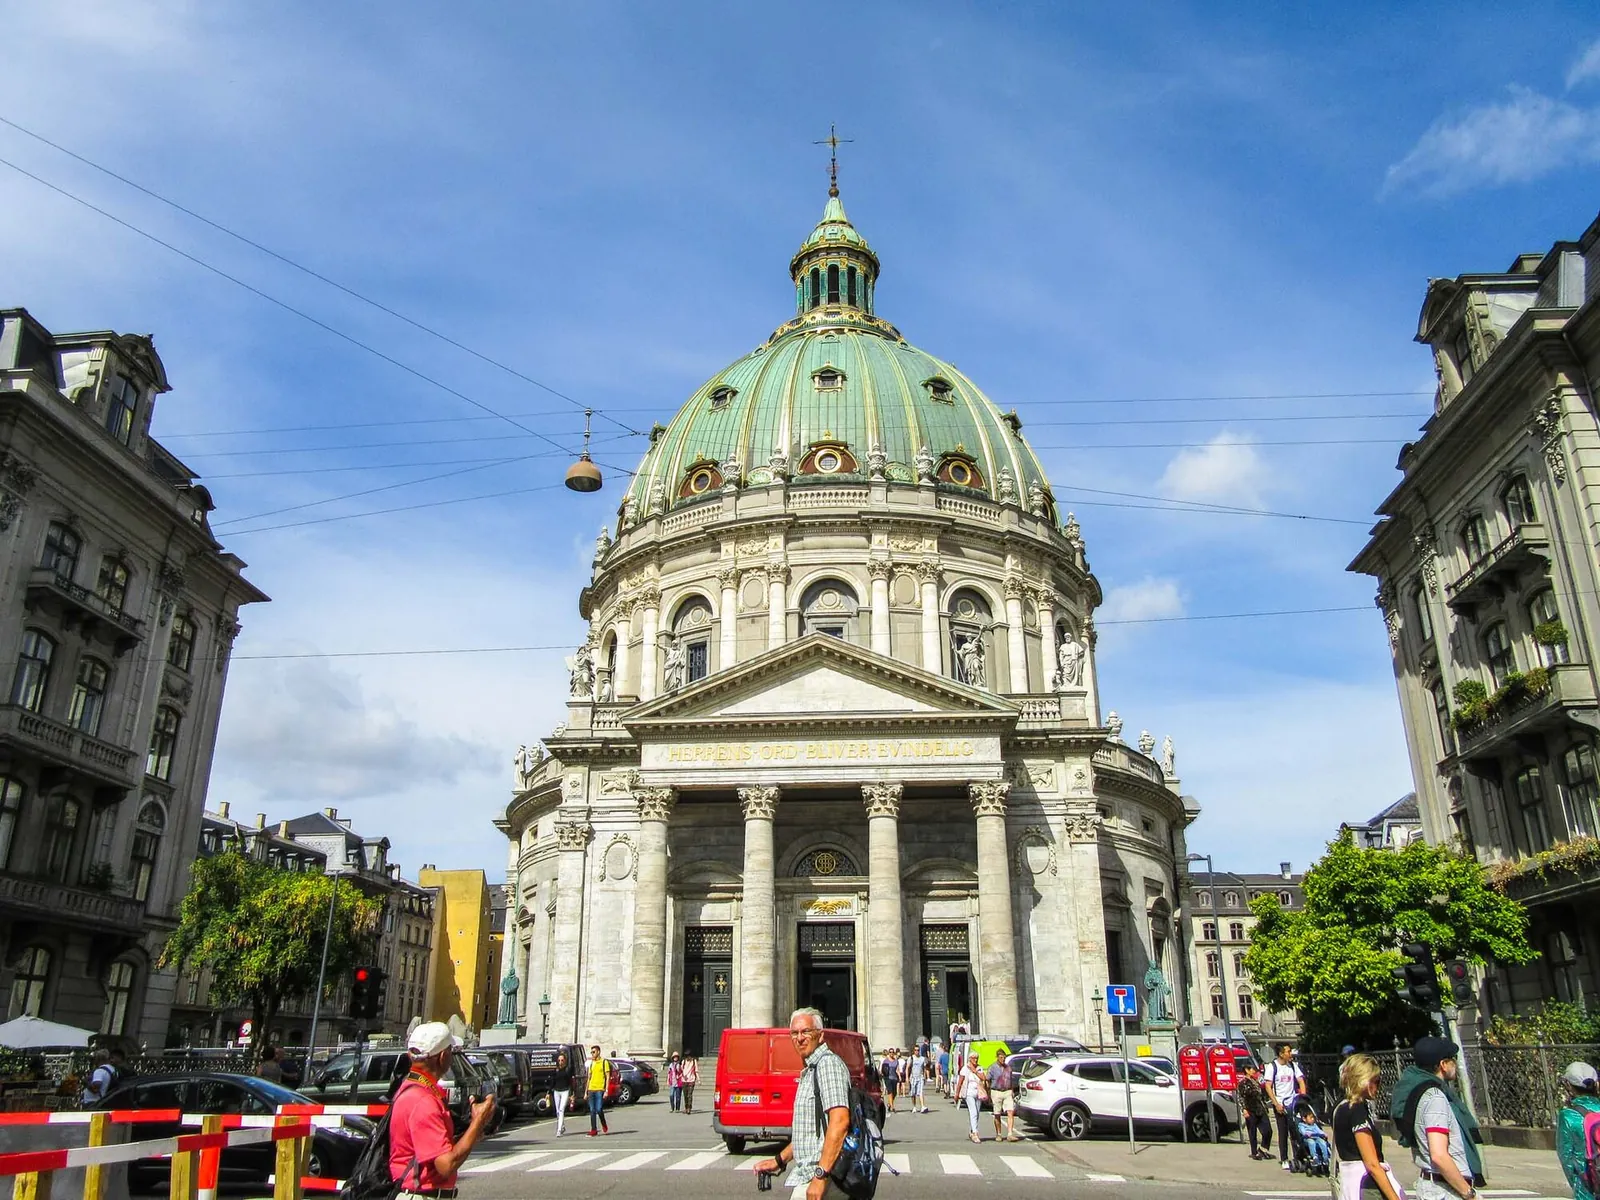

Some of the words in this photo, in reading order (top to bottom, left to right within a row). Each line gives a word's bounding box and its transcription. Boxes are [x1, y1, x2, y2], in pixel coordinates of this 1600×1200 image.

[668, 744, 752, 762] HERRENS
[761, 744, 798, 761] ORD
[806, 742, 871, 760] BLIVER
[877, 740, 974, 758] EVINDELIG
